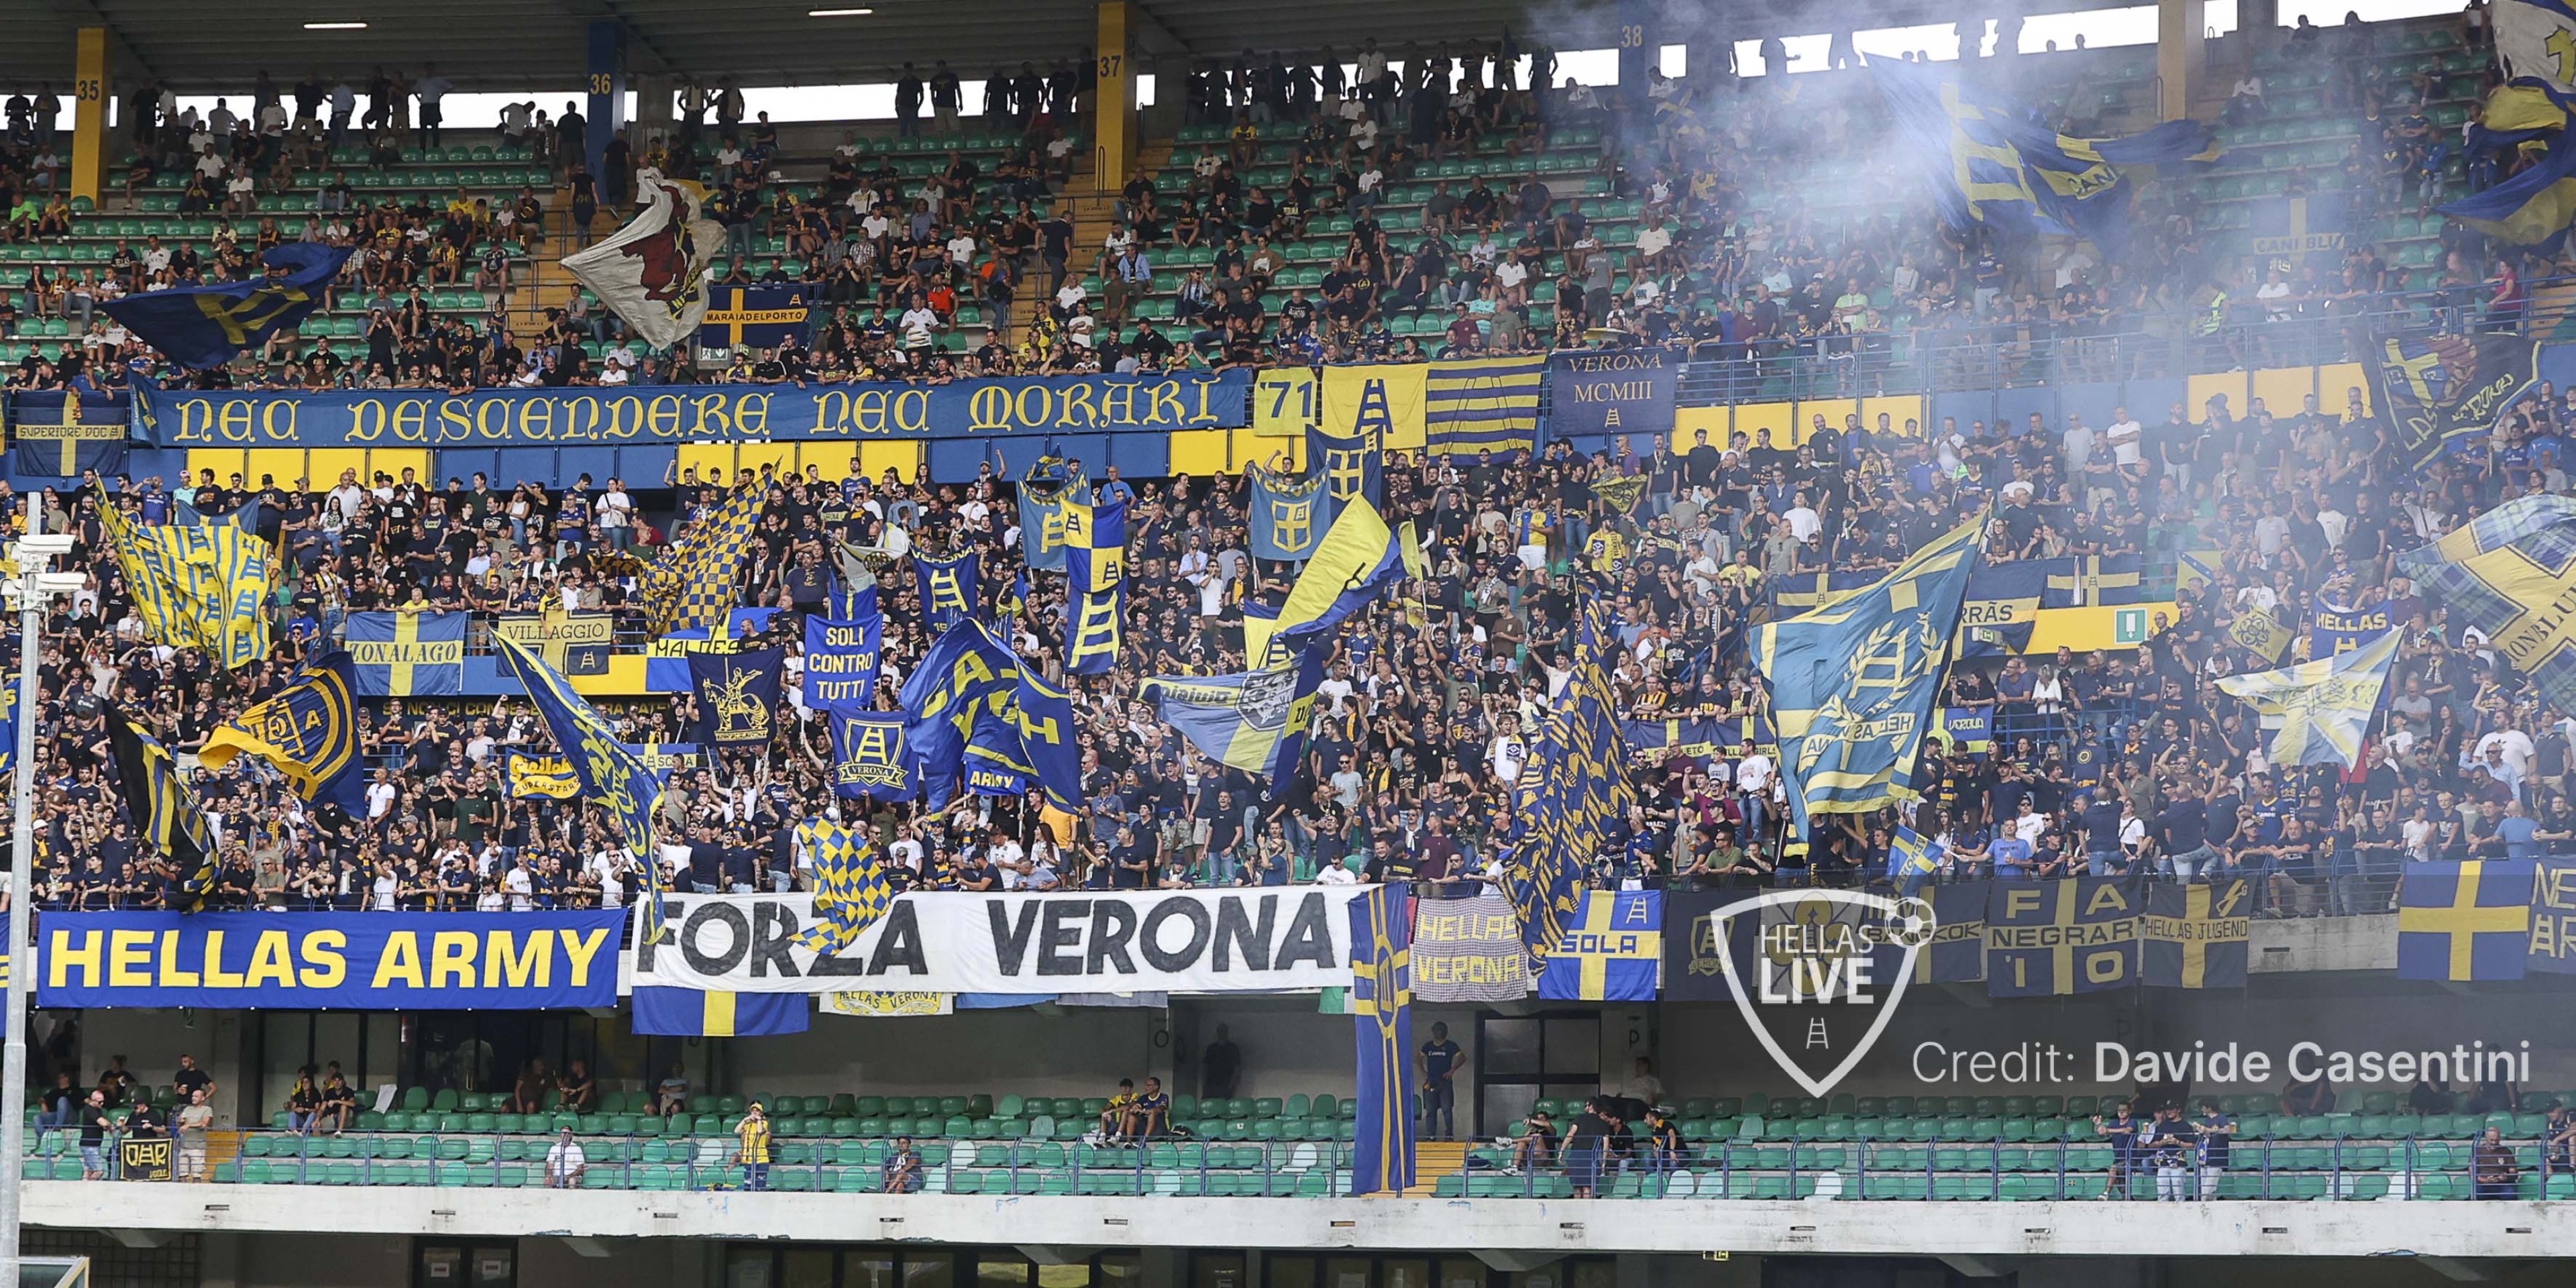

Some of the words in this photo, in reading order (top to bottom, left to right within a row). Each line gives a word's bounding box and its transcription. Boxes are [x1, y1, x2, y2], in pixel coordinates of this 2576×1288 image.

[1621, 25, 1642, 48] 38
[1100, 55, 1122, 78] 37
[78, 80, 99, 101] 35
[590, 73, 611, 96] 36
[2256, 238, 2299, 253] CANI
[706, 311, 803, 321] MARAIADELPORTO
[1568, 353, 1662, 374] VERONA
[1574, 380, 1653, 403] MCMIII
[174, 398, 302, 443] NEC
[344, 392, 773, 443] DESCENDERE
[810, 389, 933, 435] NEC
[968, 377, 1219, 433] MORARI
[20, 426, 82, 437] SUPERIORE
[911, 544, 974, 564] VERONA
[2316, 611, 2387, 631] HELLAS
[507, 623, 604, 641] VILLAGGIO
[826, 627, 863, 646] SOLI
[350, 643, 457, 662] ZONALAGO
[809, 651, 873, 674] CONTRO
[816, 679, 865, 700] TUTTI
[657, 756, 694, 767] SCA
[851, 765, 890, 776] VERONA
[986, 892, 1336, 978] VERONA
[1418, 914, 1518, 941] HELLAS
[1992, 920, 2134, 947] NEGRAR
[2146, 918, 2192, 939] HELLAS
[2198, 919, 2249, 940] JUGEND
[48, 929, 347, 989] HELLAS
[371, 927, 610, 989] ARMY
[1417, 954, 1520, 984] VERONA
[839, 991, 881, 1008] HELLAS
[890, 991, 937, 1008] VERONA
